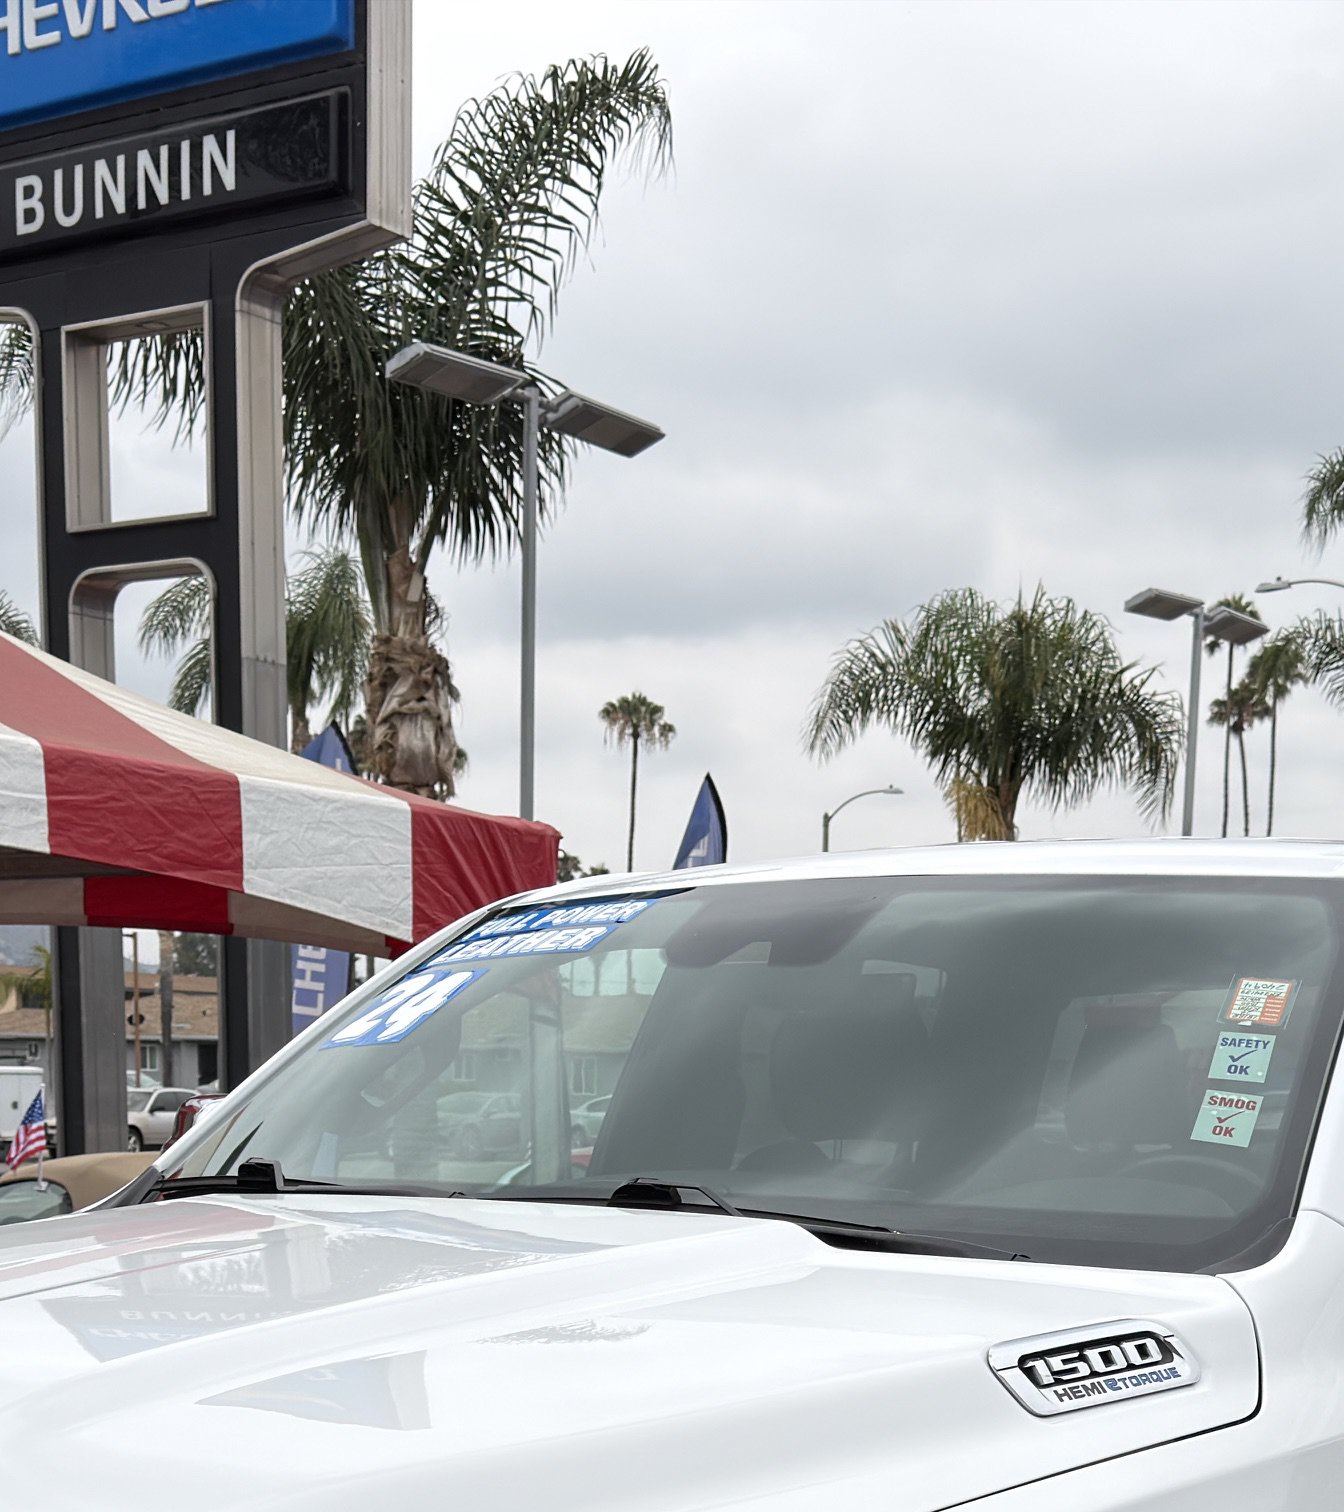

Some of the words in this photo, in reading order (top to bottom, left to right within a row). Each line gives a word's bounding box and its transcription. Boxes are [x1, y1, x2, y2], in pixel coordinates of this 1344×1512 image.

[14, 129, 237, 236] BUNNIN
[461, 911, 539, 940] FULL
[538, 899, 649, 928] POWER
[428, 925, 609, 967] LEATHER
[329, 969, 476, 1044] 24
[1219, 1036, 1271, 1050] SAFETY
[1226, 1063, 1251, 1076] OK
[1207, 1095, 1258, 1111] SMOG
[1211, 1124, 1236, 1138] OK
[1024, 1336, 1164, 1386] 1500
[1052, 1379, 1107, 1403] HEMI
